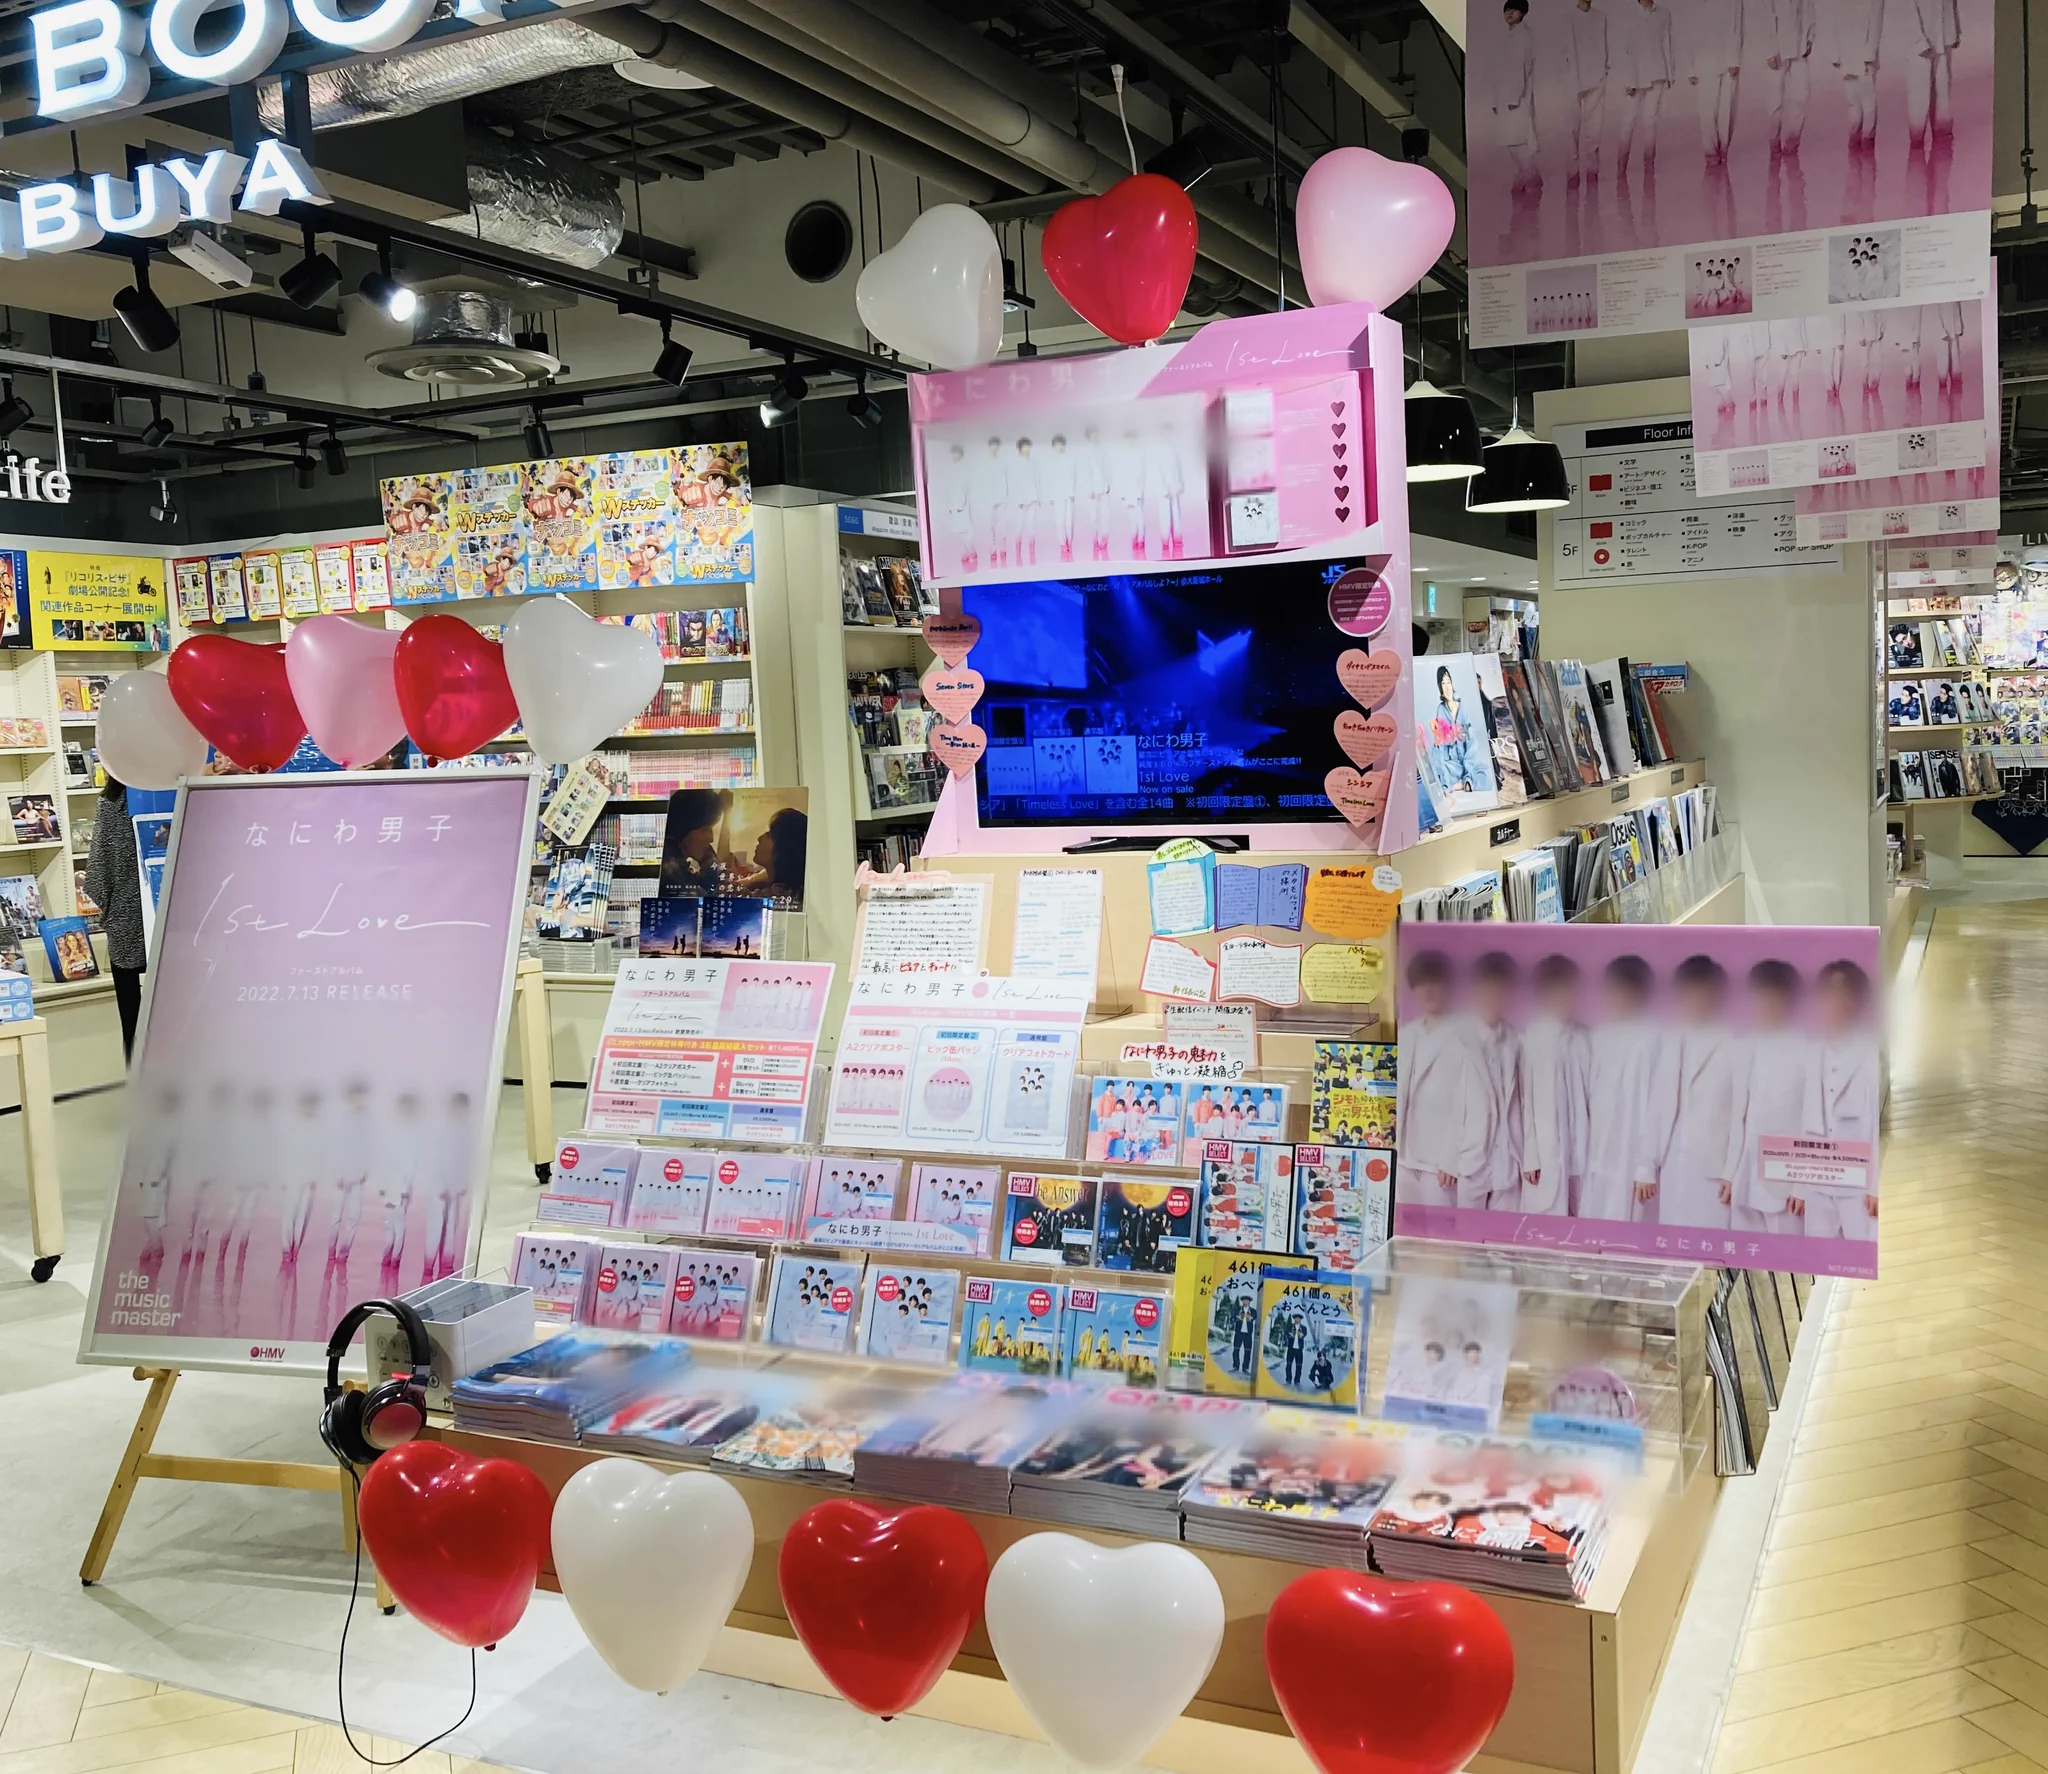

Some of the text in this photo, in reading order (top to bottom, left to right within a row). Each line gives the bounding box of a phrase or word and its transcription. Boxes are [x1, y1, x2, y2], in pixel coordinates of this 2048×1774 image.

[1643, 428, 1674, 440] Floor
[0, 455, 71, 503] ife
[1625, 519, 1647, 528] コミック
[1687, 529, 1710, 537] アイドル
[1562, 544, 1579, 557] 5F
[1687, 543, 1708, 551] K-POP
[1779, 546, 1796, 554] POP
[1137, 732, 1208, 750] なにわ男子
[1929, 749, 1960, 761] SESE
[1139, 771, 1191, 784] 1st Love
[1139, 784, 1195, 795] Now on sale
[244, 813, 455, 847] なにわ男子
[192, 872, 493, 946] 1st Love
[624, 968, 719, 985] なにわ男子
[237, 983, 414, 1004] 2022.7.13 RELEASE
[858, 980, 967, 998] なにわ男子
[1207, 1142, 1228, 1153] HMV
[1298, 1147, 1319, 1158] HMV
[1207, 1151, 1228, 1160] SELECT
[1298, 1155, 1319, 1165] SELECT
[1013, 1178, 1031, 1187] HMV
[1012, 1185, 1031, 1193] SELECT
[828, 1223, 955, 1244] なにわ男子 1st Love
[1558, 1224, 1640, 1250] Love
[1655, 1235, 1762, 1258] なにわ男子
[118, 1269, 150, 1289] the
[969, 1283, 989, 1294] HMV
[1282, 1285, 1331, 1301] 461個の
[114, 1288, 172, 1307] music
[969, 1292, 988, 1300] SELECT
[1073, 1291, 1094, 1302] HMV
[1073, 1299, 1092, 1308] SELECT
[1282, 1299, 1342, 1318] おべんとう
[110, 1308, 183, 1328] master
[260, 1346, 287, 1360] HMV
